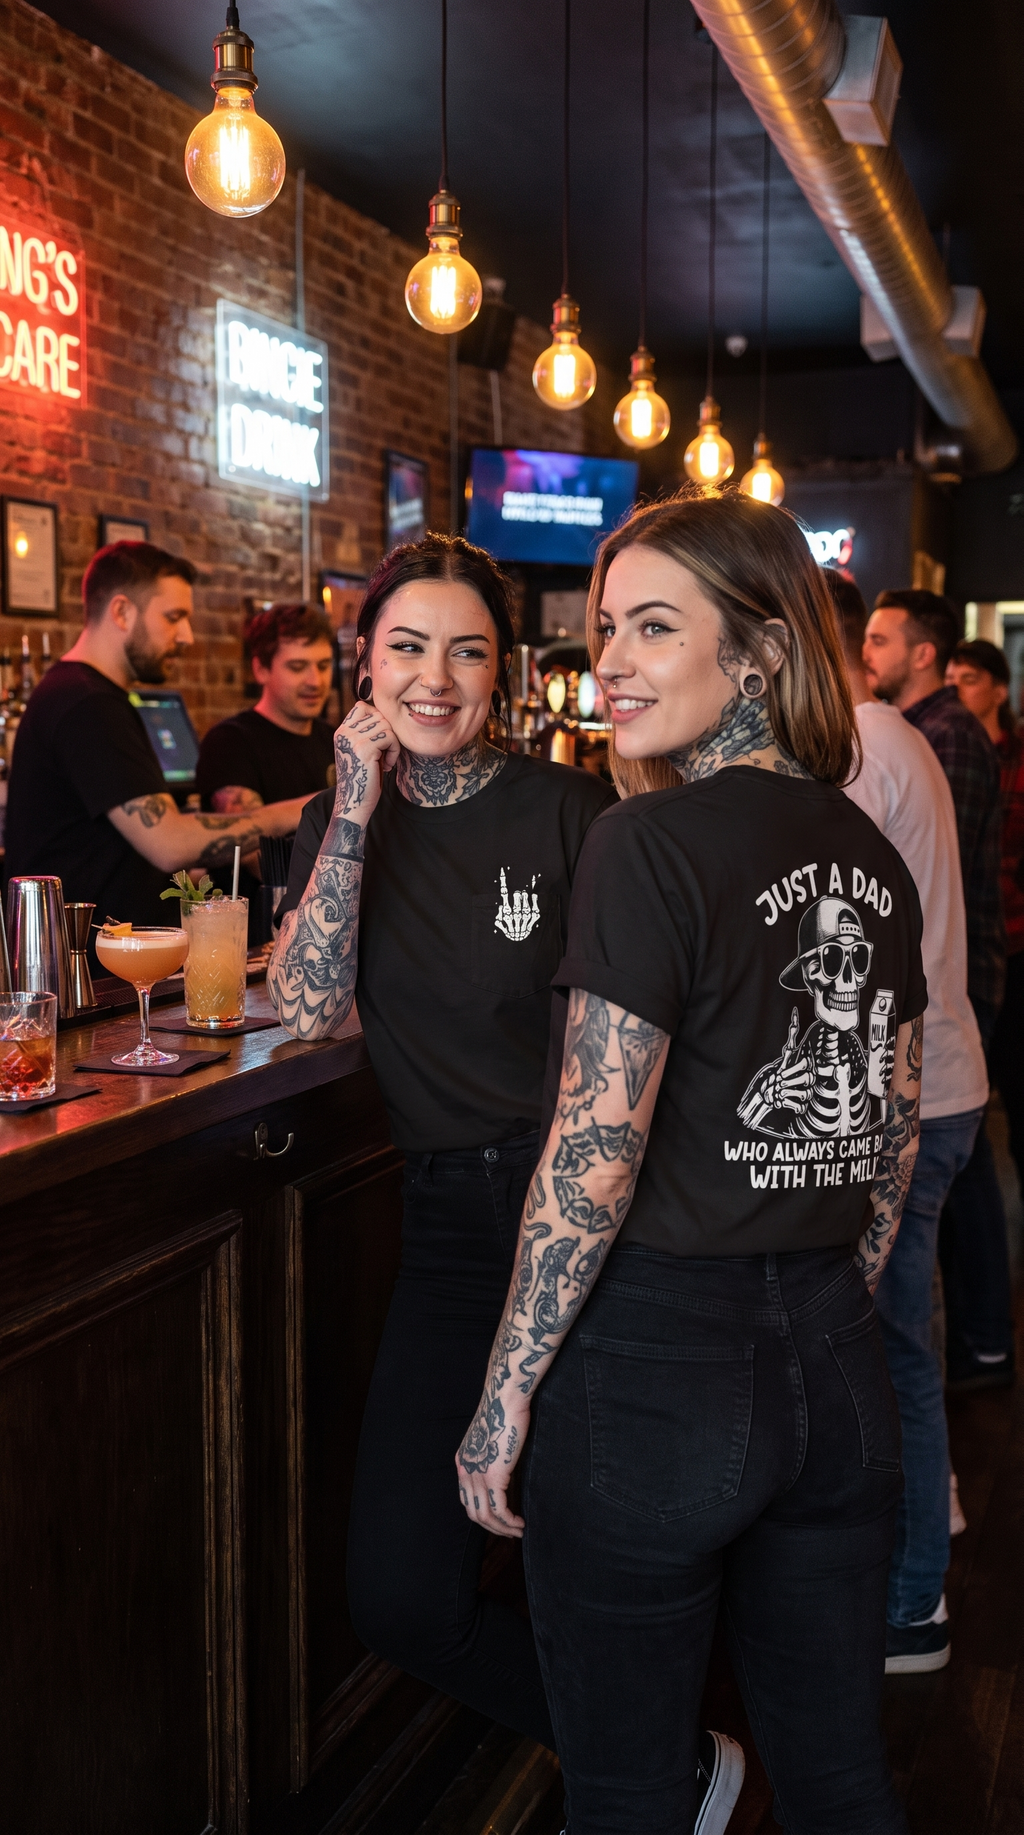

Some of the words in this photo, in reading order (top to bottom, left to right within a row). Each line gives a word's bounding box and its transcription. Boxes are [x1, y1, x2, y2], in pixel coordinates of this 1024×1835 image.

[755, 862, 818, 926] JUST
[828, 862, 844, 895] A
[852, 866, 893, 918] DAD
[871, 1023, 886, 1042] MILK
[723, 1140, 769, 1162] WHO
[771, 1140, 835, 1162] ALWAYS
[838, 1136, 872, 1159] CAME
[749, 1164, 807, 1189] WITH
[813, 1162, 845, 1188] THE
